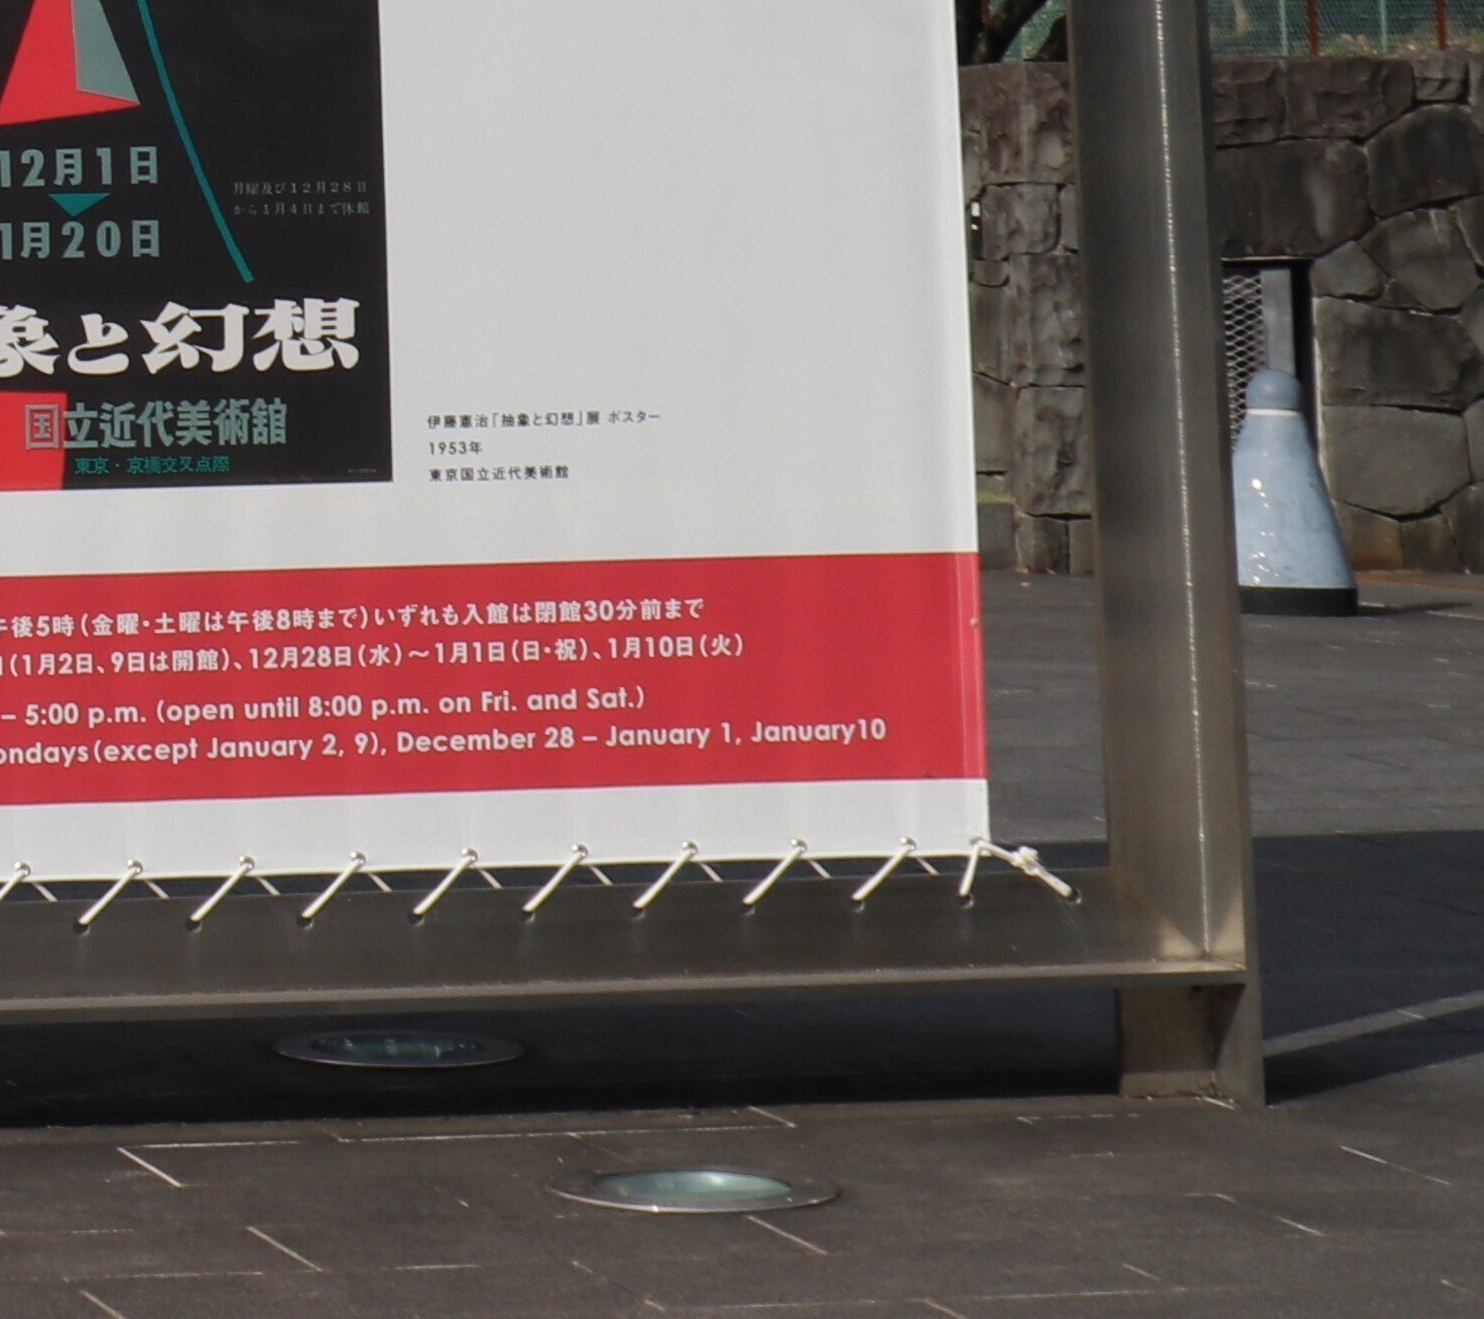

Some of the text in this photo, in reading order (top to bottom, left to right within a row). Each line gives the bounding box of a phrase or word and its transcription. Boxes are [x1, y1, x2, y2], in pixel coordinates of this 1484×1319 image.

[608, 410, 660, 424] ポスター
[429, 440, 482, 456] 1953年
[429, 465, 569, 482] 東京国立近代美術館
[24, 702, 80, 726] 5:00
[88, 706, 147, 729] p.m.
[156, 699, 234, 726] (open
[244, 696, 299, 720] until
[308, 694, 362, 718] 8:00
[371, 697, 429, 721] p.m.
[438, 696, 471, 714] on
[481, 689, 517, 713] Fri.
[526, 688, 578, 711] and
[586, 685, 644, 710] Sat.)
[206, 737, 313, 761] January
[321, 733, 345, 758] 2,
[354, 731, 387, 756] 9),
[396, 728, 536, 753] December
[544, 726, 575, 749] 28
[605, 725, 711, 749] January
[721, 722, 742, 745] 1,
